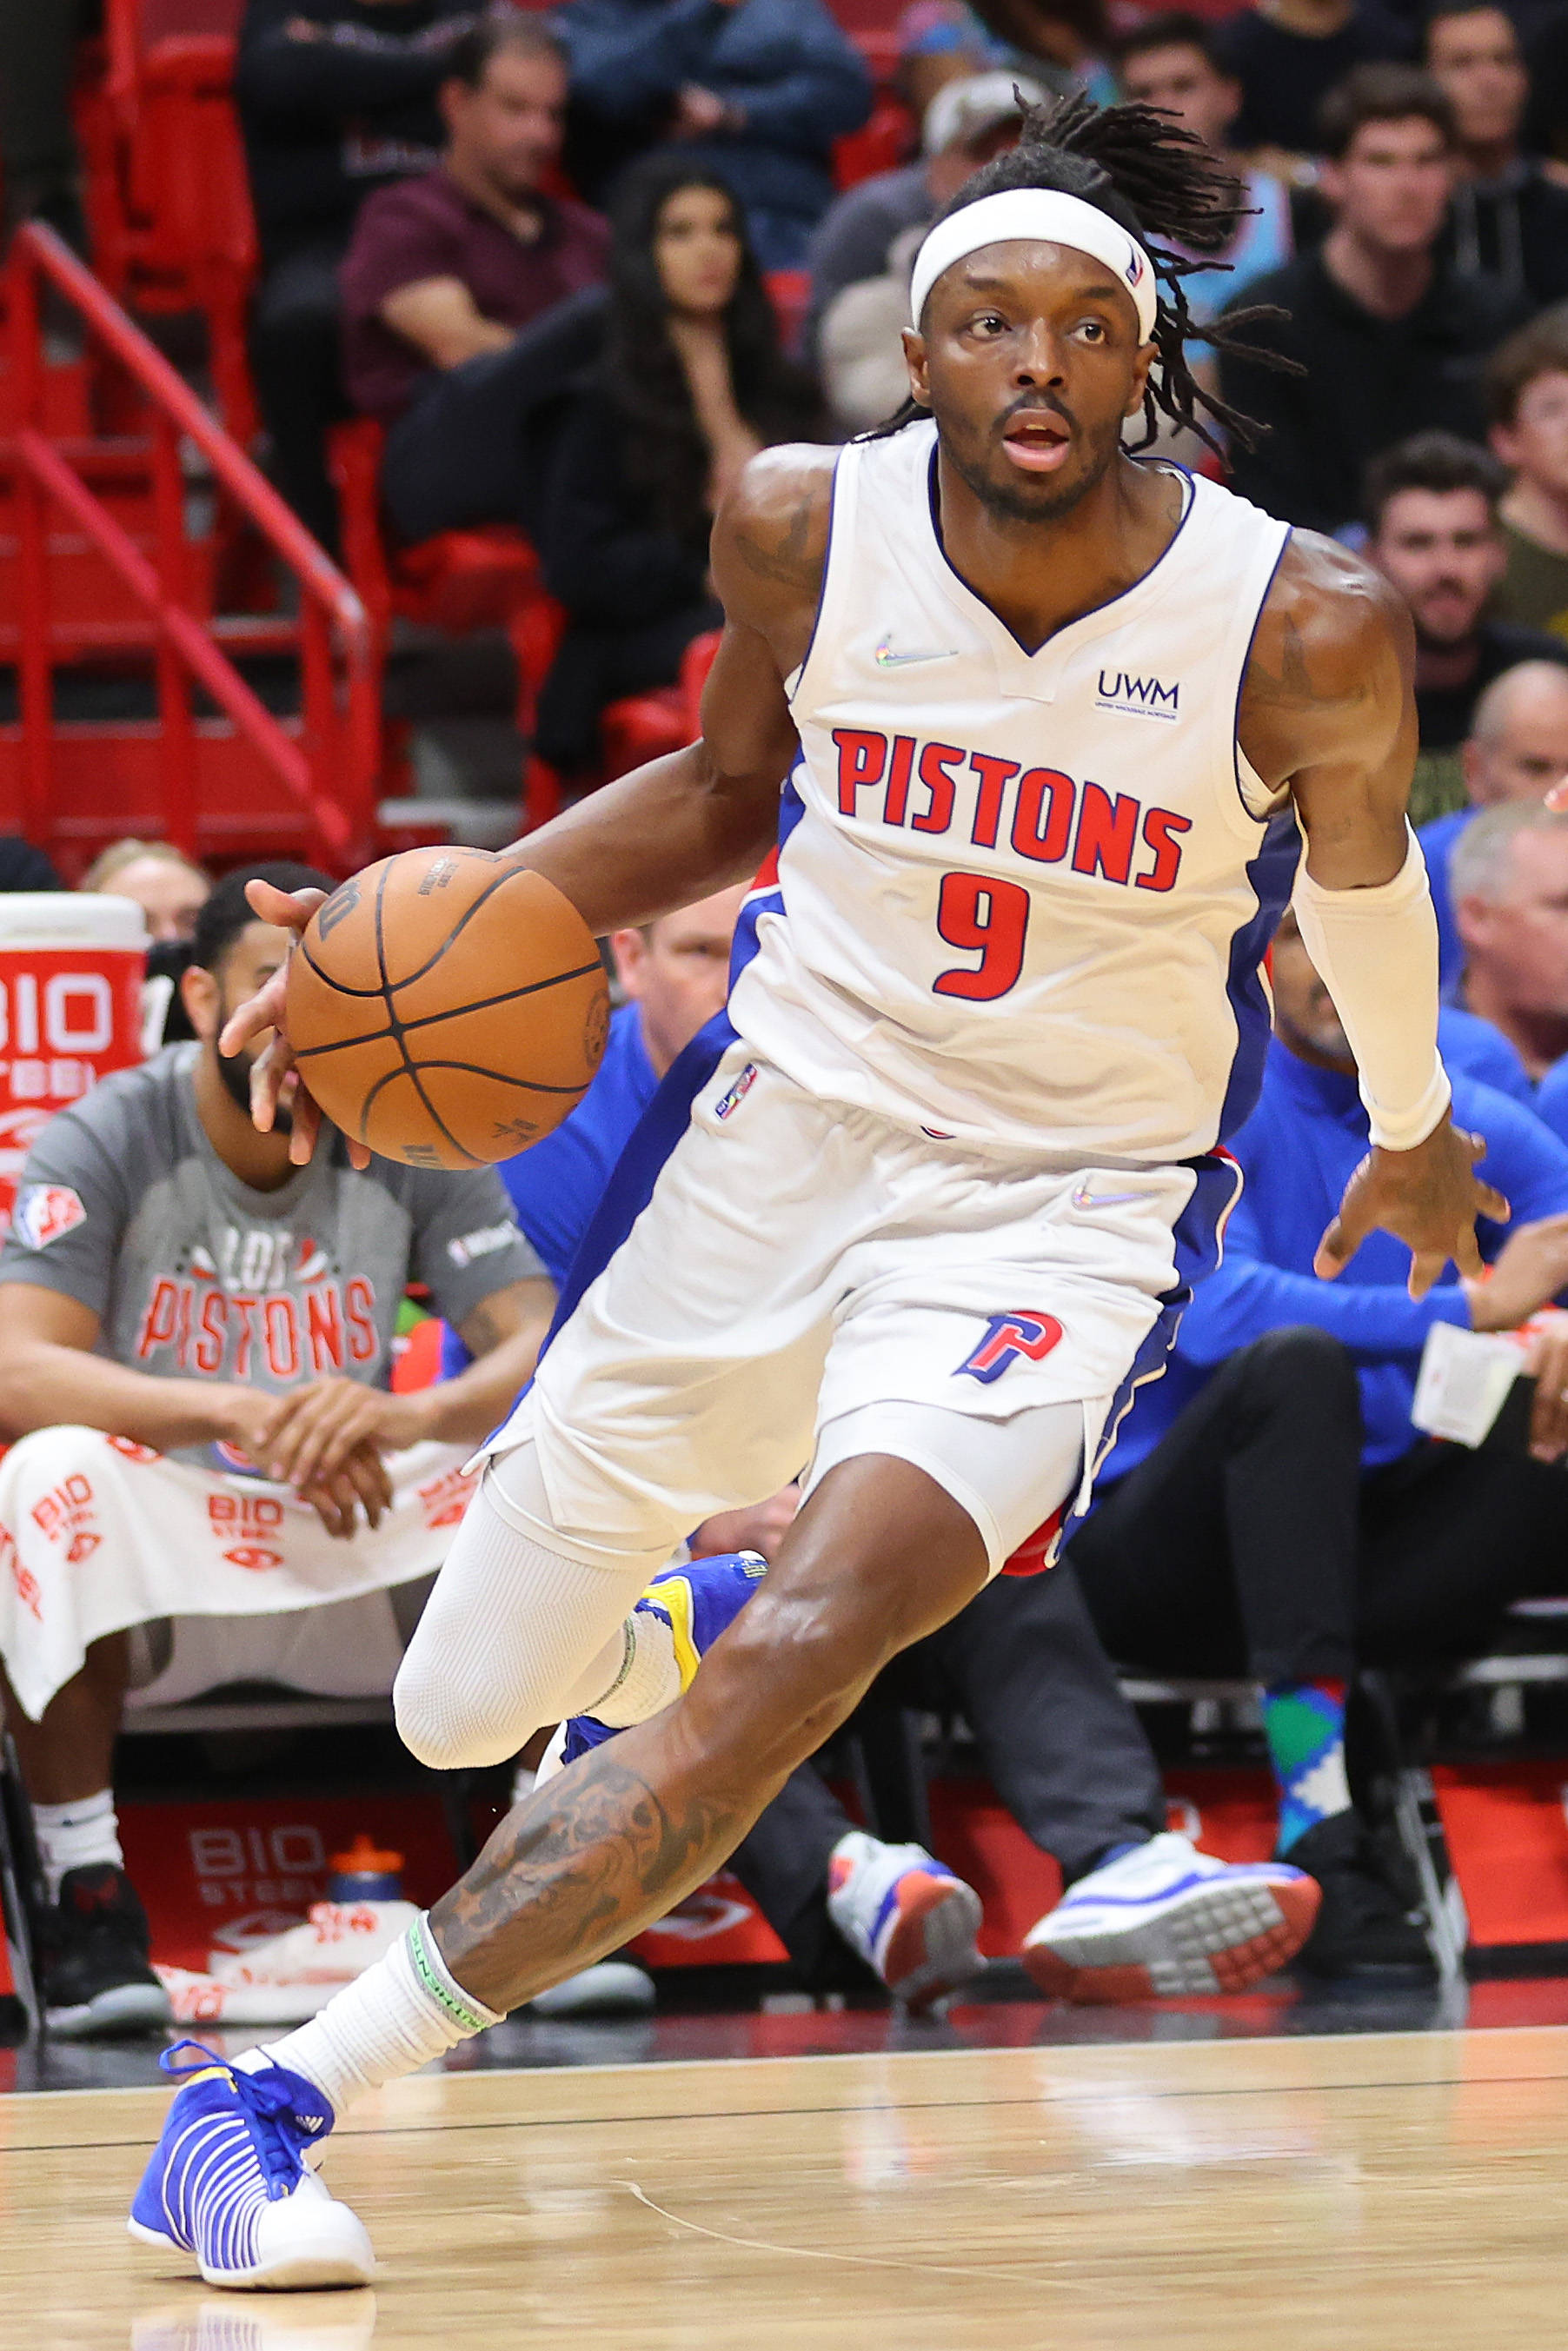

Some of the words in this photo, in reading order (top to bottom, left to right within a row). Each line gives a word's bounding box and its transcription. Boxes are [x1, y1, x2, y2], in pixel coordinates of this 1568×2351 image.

[1098, 669, 1179, 710] UWM
[832, 727, 1193, 893] PISTONS
[932, 871, 1031, 1002] 9
[0, 973, 113, 1053] IO
[136, 1273, 380, 1382] PISTONS
[32, 1473, 92, 1531] BIO
[209, 1495, 283, 1525] BIO
[189, 1826, 325, 1876] BIO
